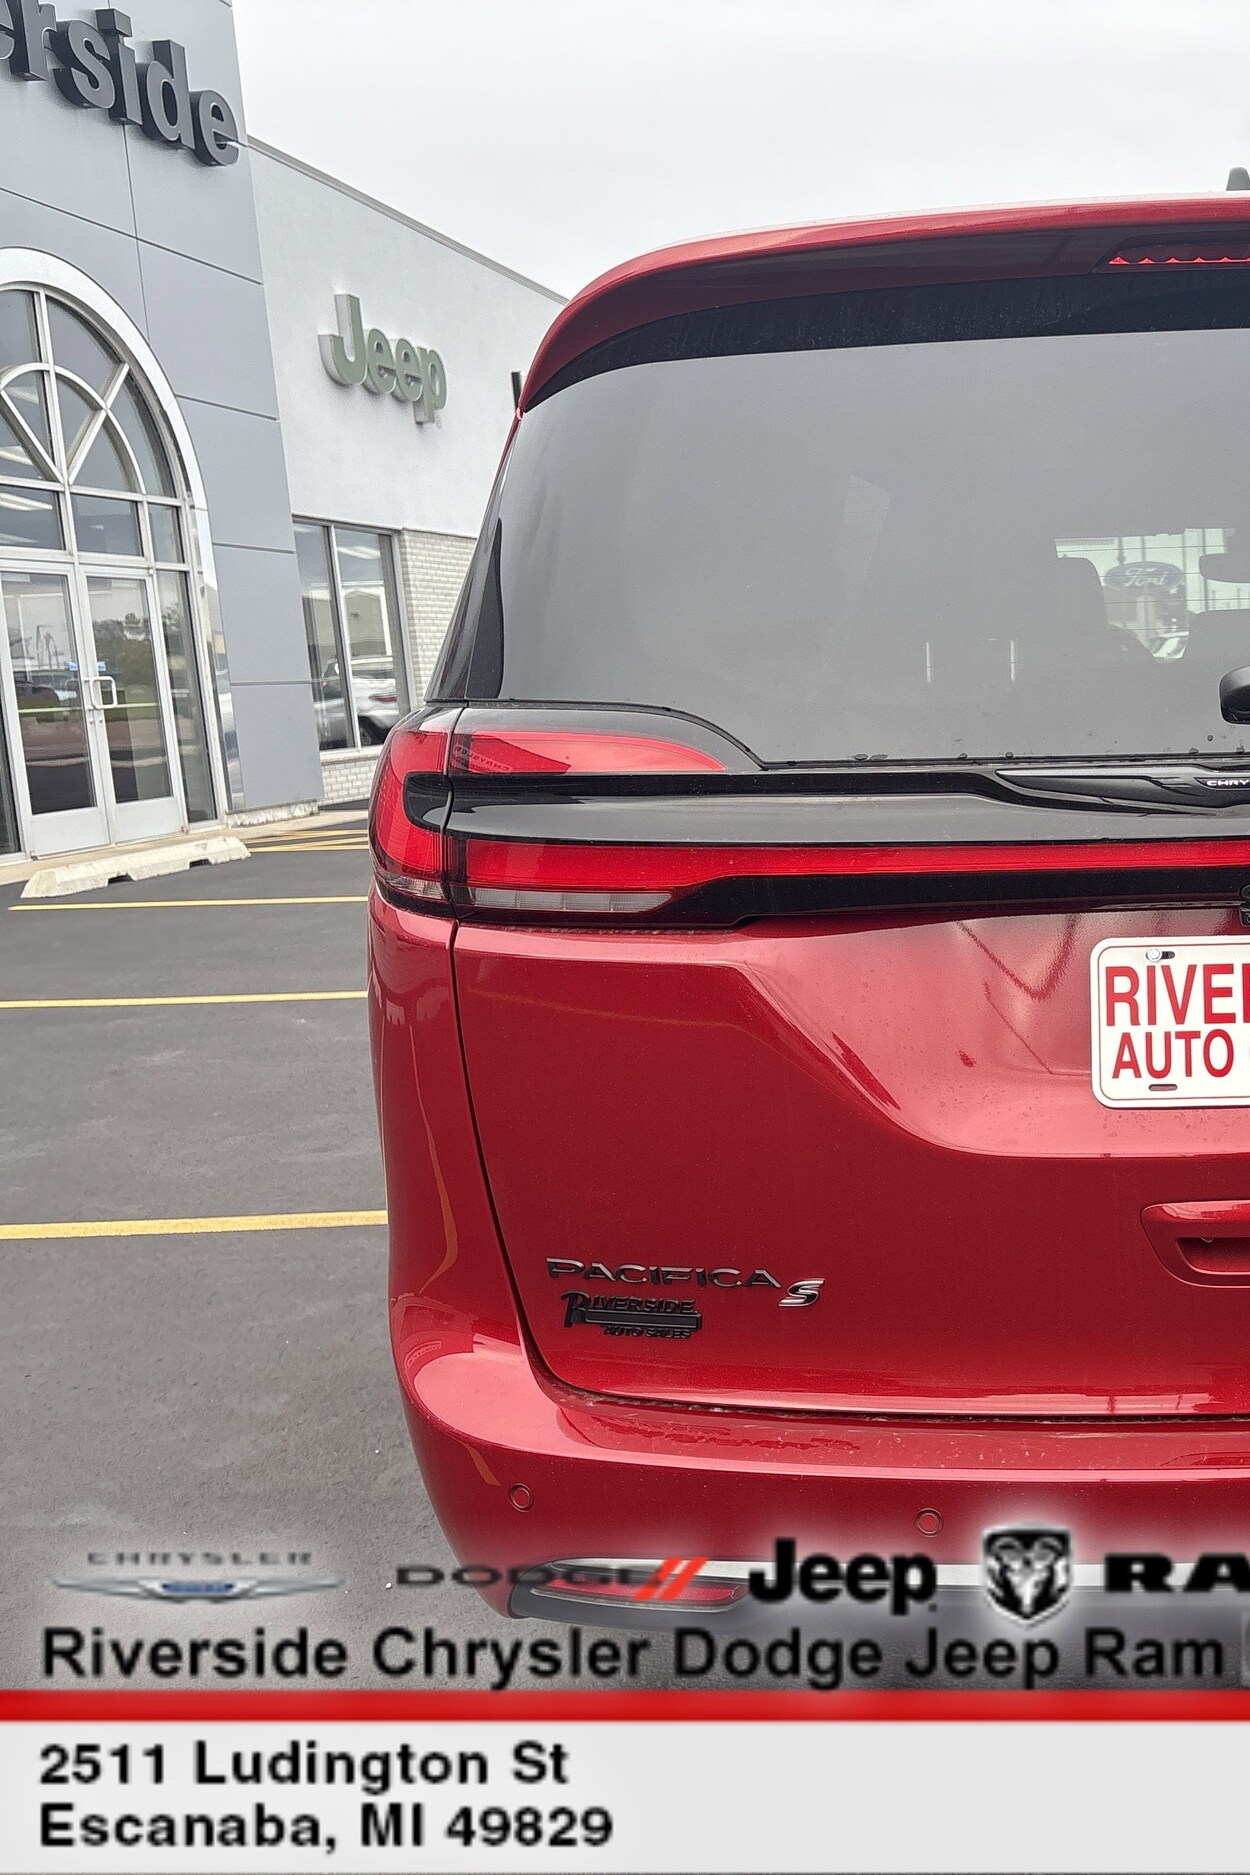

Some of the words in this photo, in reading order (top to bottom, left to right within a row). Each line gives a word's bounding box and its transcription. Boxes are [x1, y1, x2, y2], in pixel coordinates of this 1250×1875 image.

[319, 293, 447, 425] Jeep
[1112, 1028, 1235, 1079] AUTO
[546, 1257, 782, 1289] PACIFICA
[778, 1277, 826, 1308] S
